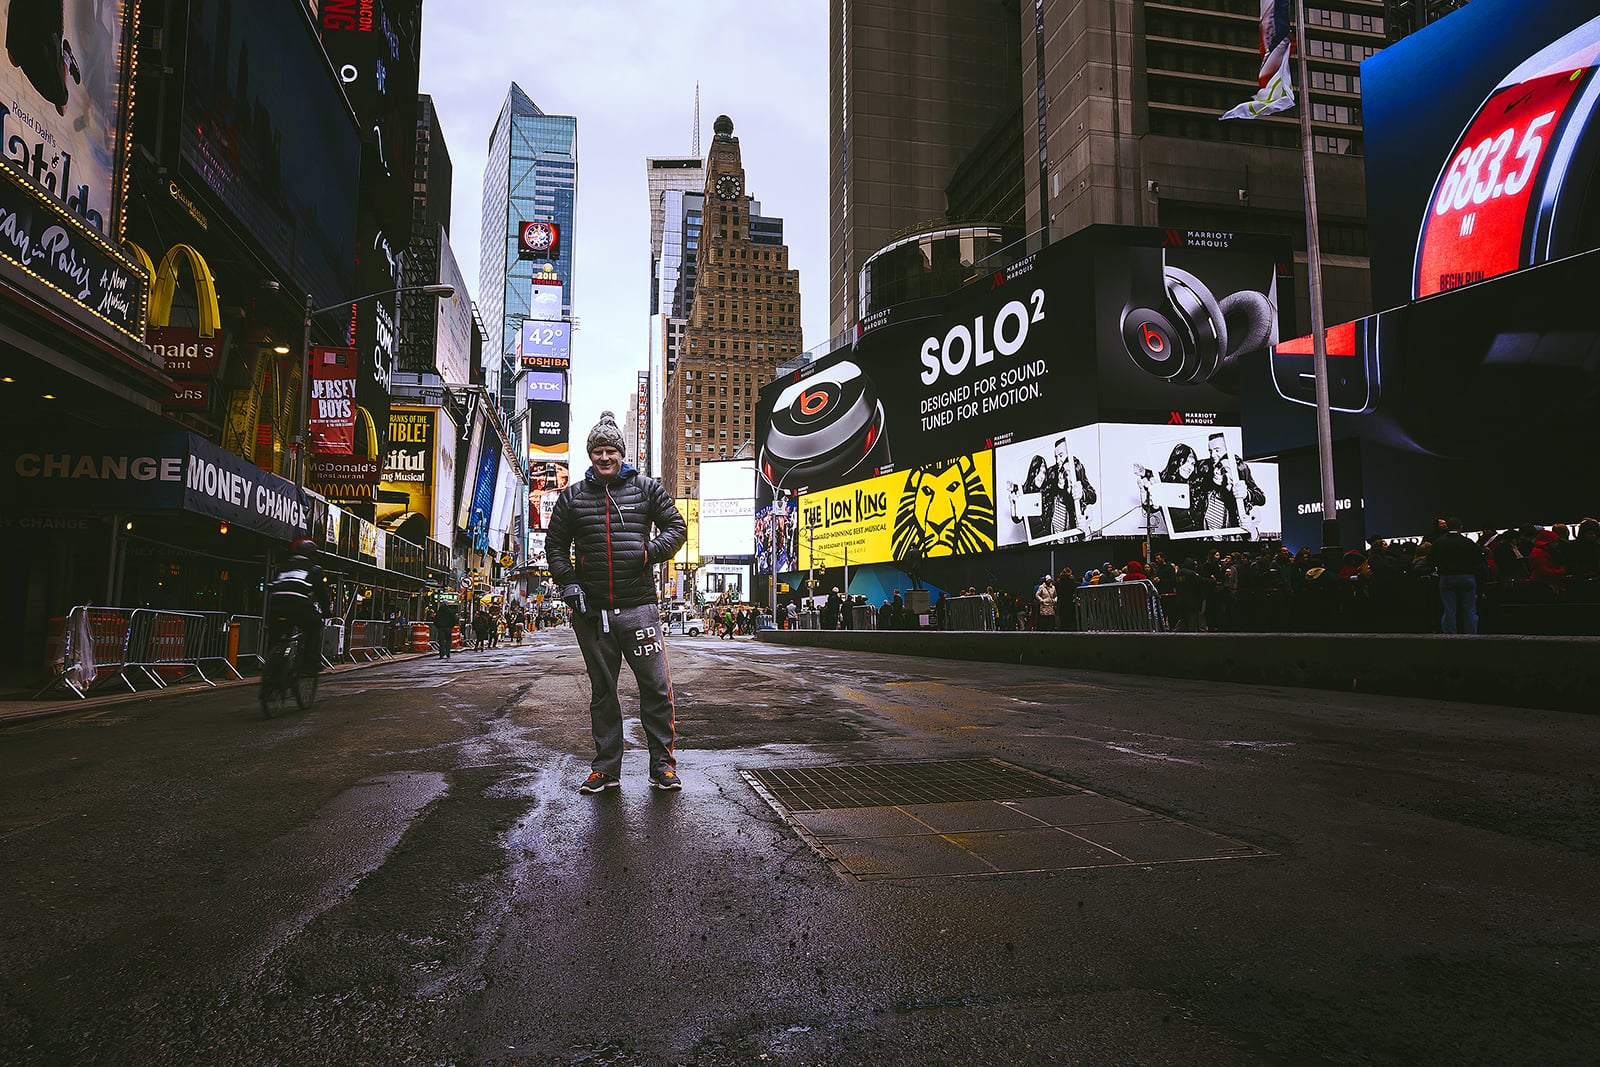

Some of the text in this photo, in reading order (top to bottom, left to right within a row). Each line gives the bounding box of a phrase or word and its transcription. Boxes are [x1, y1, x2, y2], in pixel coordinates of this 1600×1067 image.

[12, 100, 58, 148] Roald Dahl's
[1436, 110, 1556, 216] 683.5
[1459, 212, 1476, 238] MI
[1187, 231, 1234, 240] MARRIOTT
[1187, 239, 1229, 248] MARQUIS
[32, 243, 45, 259] in
[41, 225, 92, 300] Paris
[1006, 254, 1037, 273] MARRIOTT
[1006, 264, 1034, 280] MARQUIS
[99, 268, 128, 290] A New
[536, 272, 558, 280] 2015
[1440, 273, 1463, 292] BEGIN
[98, 290, 130, 320] Musical
[522, 357, 568, 367] TOSHIBA
[312, 379, 356, 399] JERSEY
[540, 382, 560, 390] TDK
[920, 360, 1048, 414] DESIGNED FOR SOUND.
[318, 399, 352, 419] BOYS
[920, 382, 1042, 432] TUNED FOR EMOTION.
[390, 414, 427, 423] RANKS OF THE
[15, 453, 182, 482] CHANGE
[310, 463, 377, 472] McDonald's
[394, 472, 424, 482] Musical
[186, 454, 308, 531] MONEY CHANGE
[804, 490, 886, 528] THE LION KING
[1297, 498, 1351, 514] SAMSNG
[864, 523, 887, 534] MUSICAL
[633, 640, 662, 656] JPN
